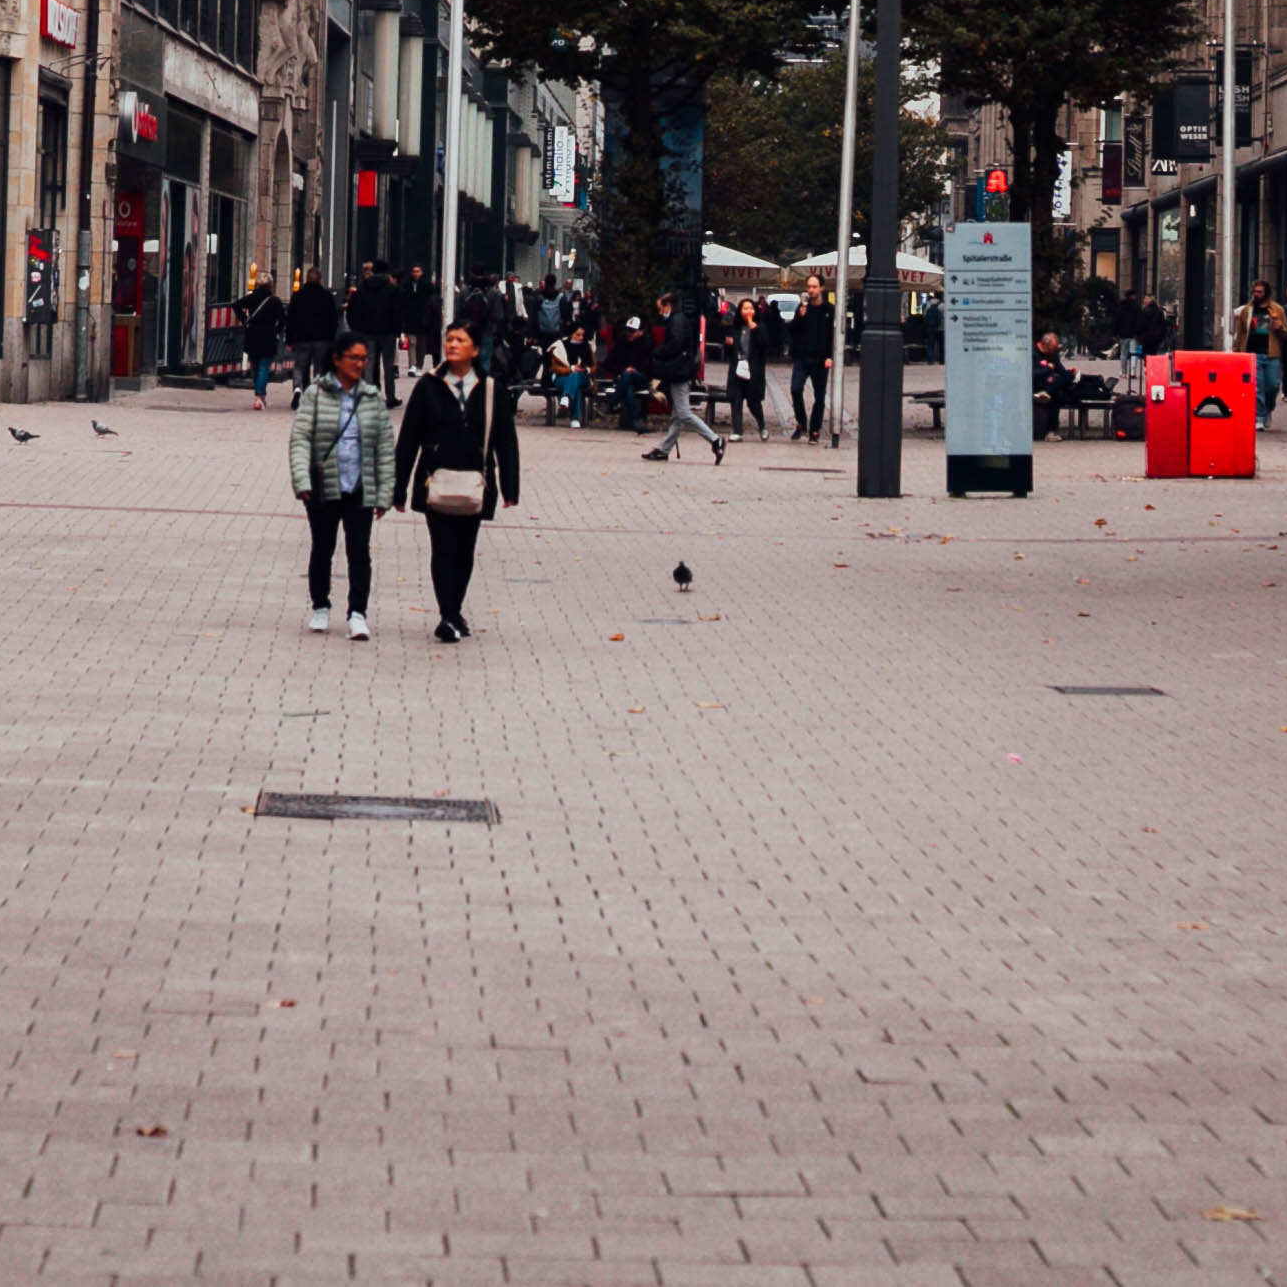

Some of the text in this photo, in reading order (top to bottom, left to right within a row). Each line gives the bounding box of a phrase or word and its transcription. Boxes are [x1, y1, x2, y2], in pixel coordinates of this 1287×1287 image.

[1218, 84, 1250, 94] LSH
[1179, 125, 1208, 133] OPTIK
[721, 265, 762, 279] VIVET
